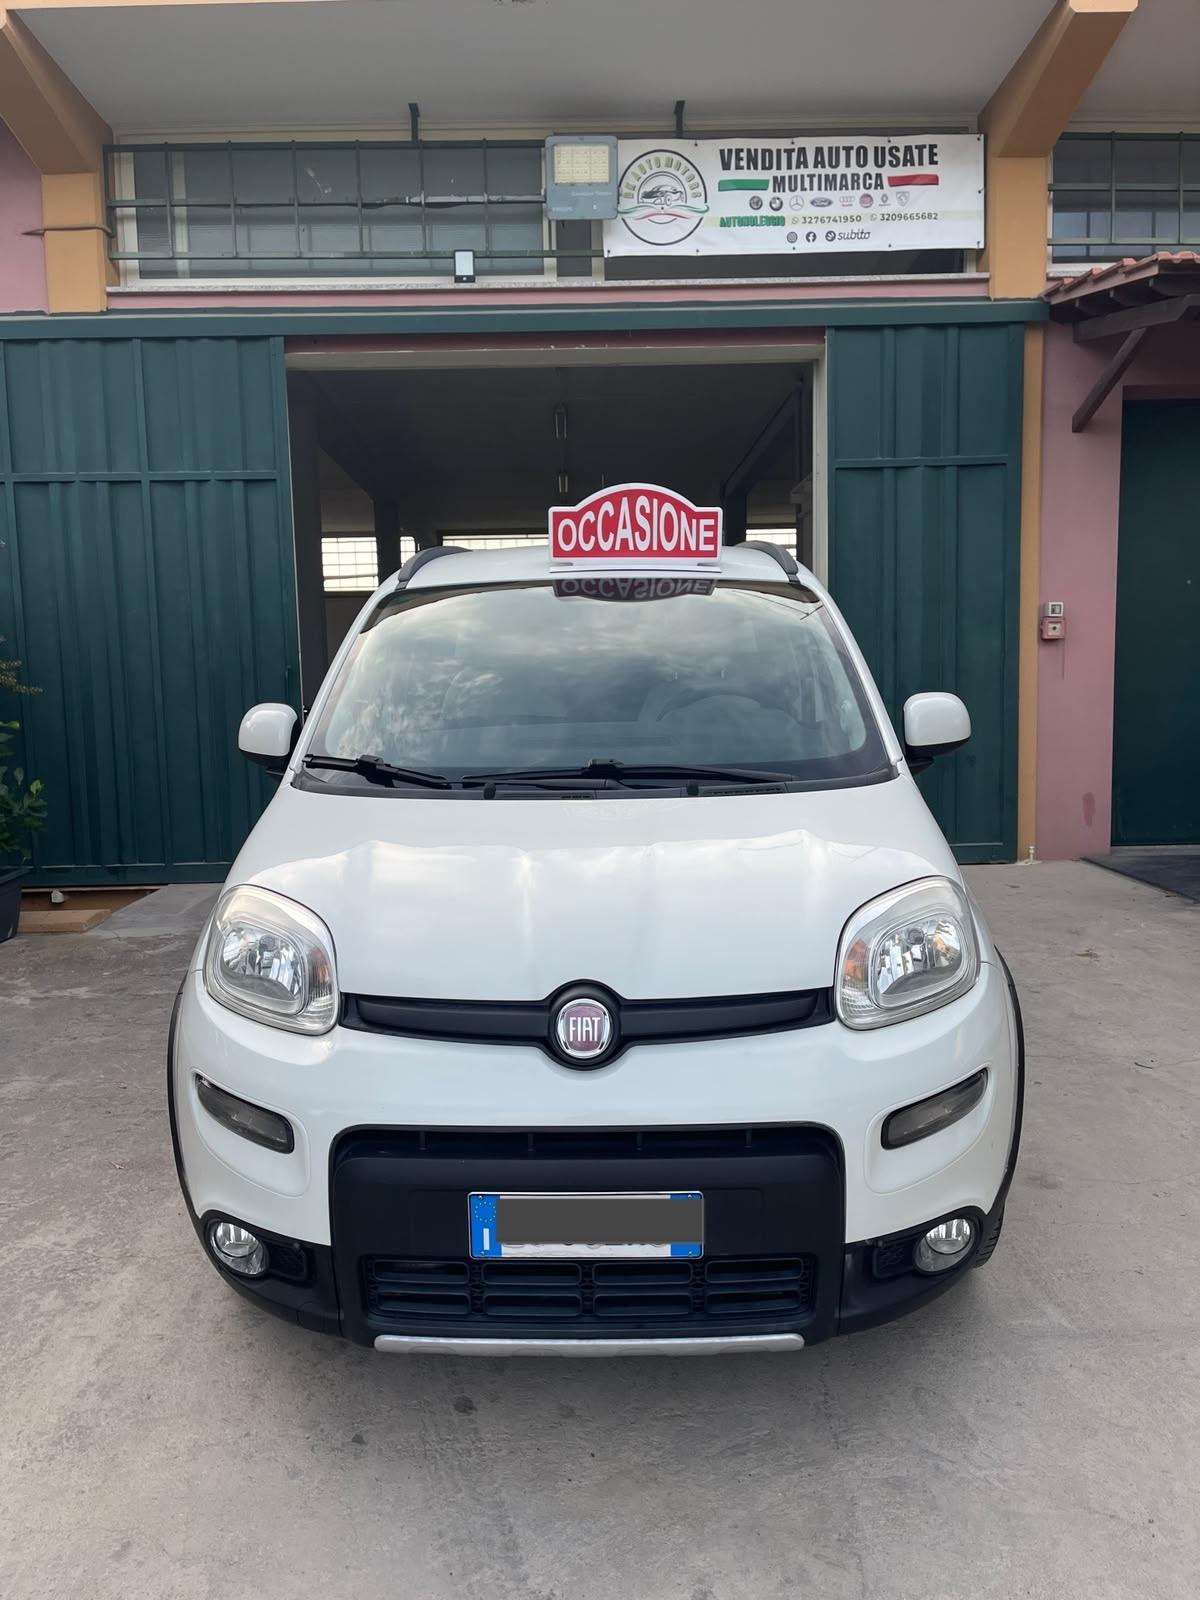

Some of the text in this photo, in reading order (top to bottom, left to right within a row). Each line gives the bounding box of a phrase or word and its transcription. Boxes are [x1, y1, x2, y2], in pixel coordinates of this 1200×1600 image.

[719, 143, 939, 171] VENDITA AUTO USATE
[772, 172, 884, 193] MULTIMARCA
[801, 214, 862, 225] 3276741950
[880, 212, 939, 222] 3209665682
[837, 228, 871, 241] subito
[557, 495, 715, 552] OCCASIONE
[569, 1016, 601, 1042] FIAT
